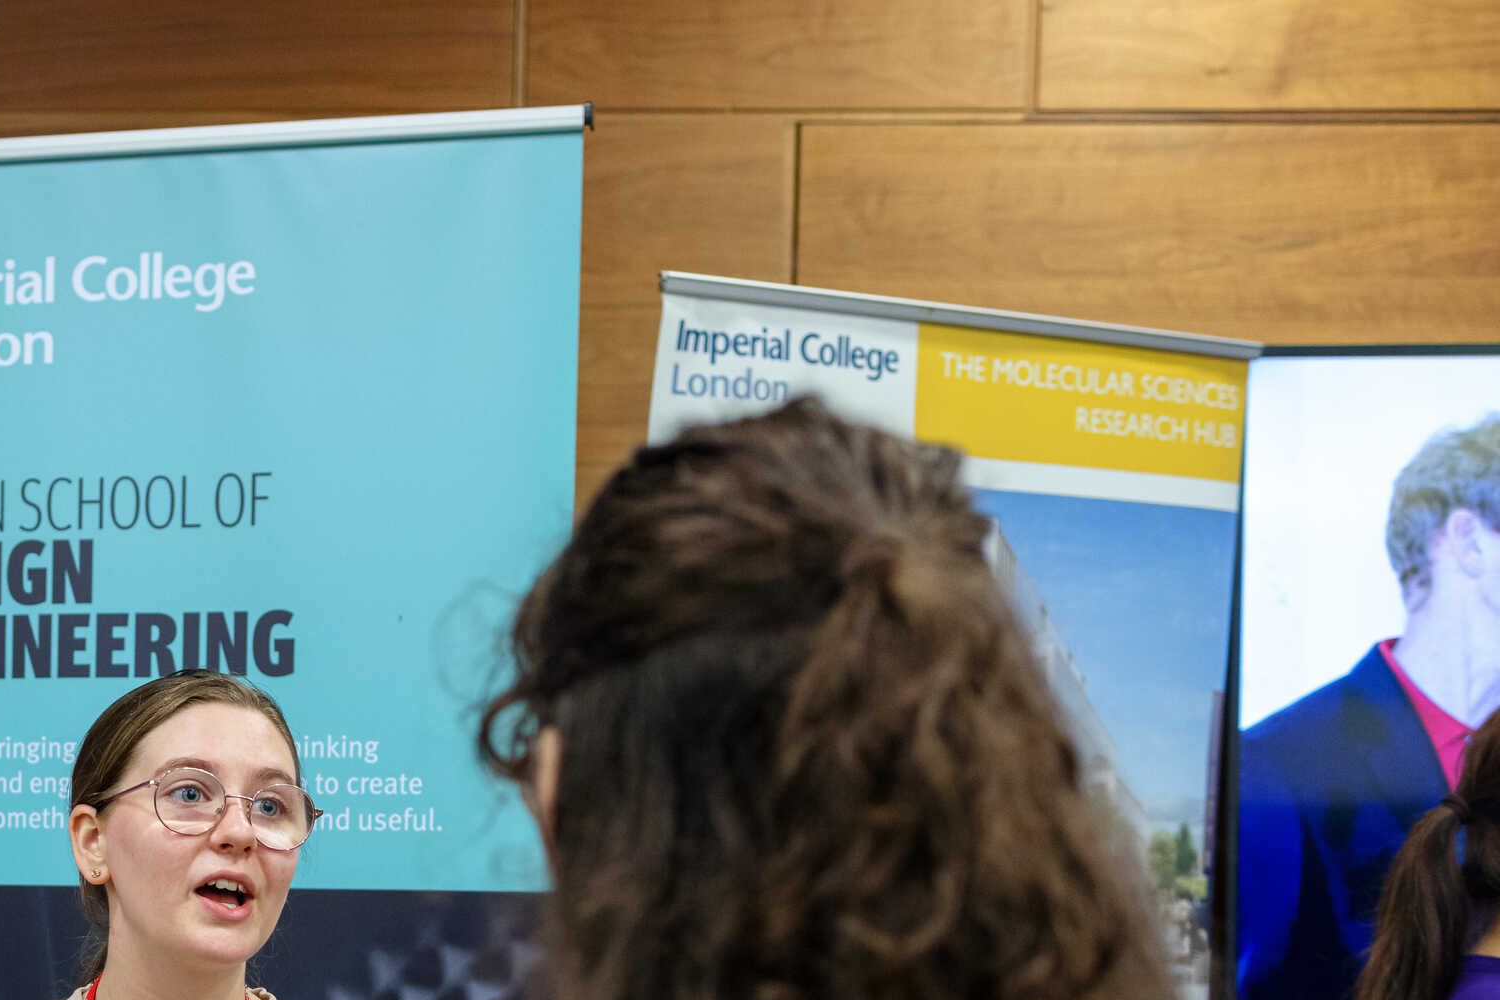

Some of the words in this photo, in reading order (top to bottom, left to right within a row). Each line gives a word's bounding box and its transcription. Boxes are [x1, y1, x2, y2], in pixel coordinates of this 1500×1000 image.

[72, 253, 257, 312] College
[676, 319, 790, 369] Imperial
[800, 332, 900, 382] College
[670, 362, 788, 402] London
[941, 351, 987, 383] THE
[992, 357, 1136, 399] MOLECULAR
[1140, 366, 1239, 411] SCIENCES
[1074, 406, 1189, 443] RESEARCH
[1193, 415, 1238, 448] HUB
[19, 474, 202, 533] SCHOOL
[214, 471, 273, 528] OF
[295, 735, 379, 764] inking
[30, 776, 71, 799] eng
[315, 773, 339, 795] to
[347, 773, 423, 796] create
[316, 807, 350, 831] nd
[359, 807, 443, 831] useful.
